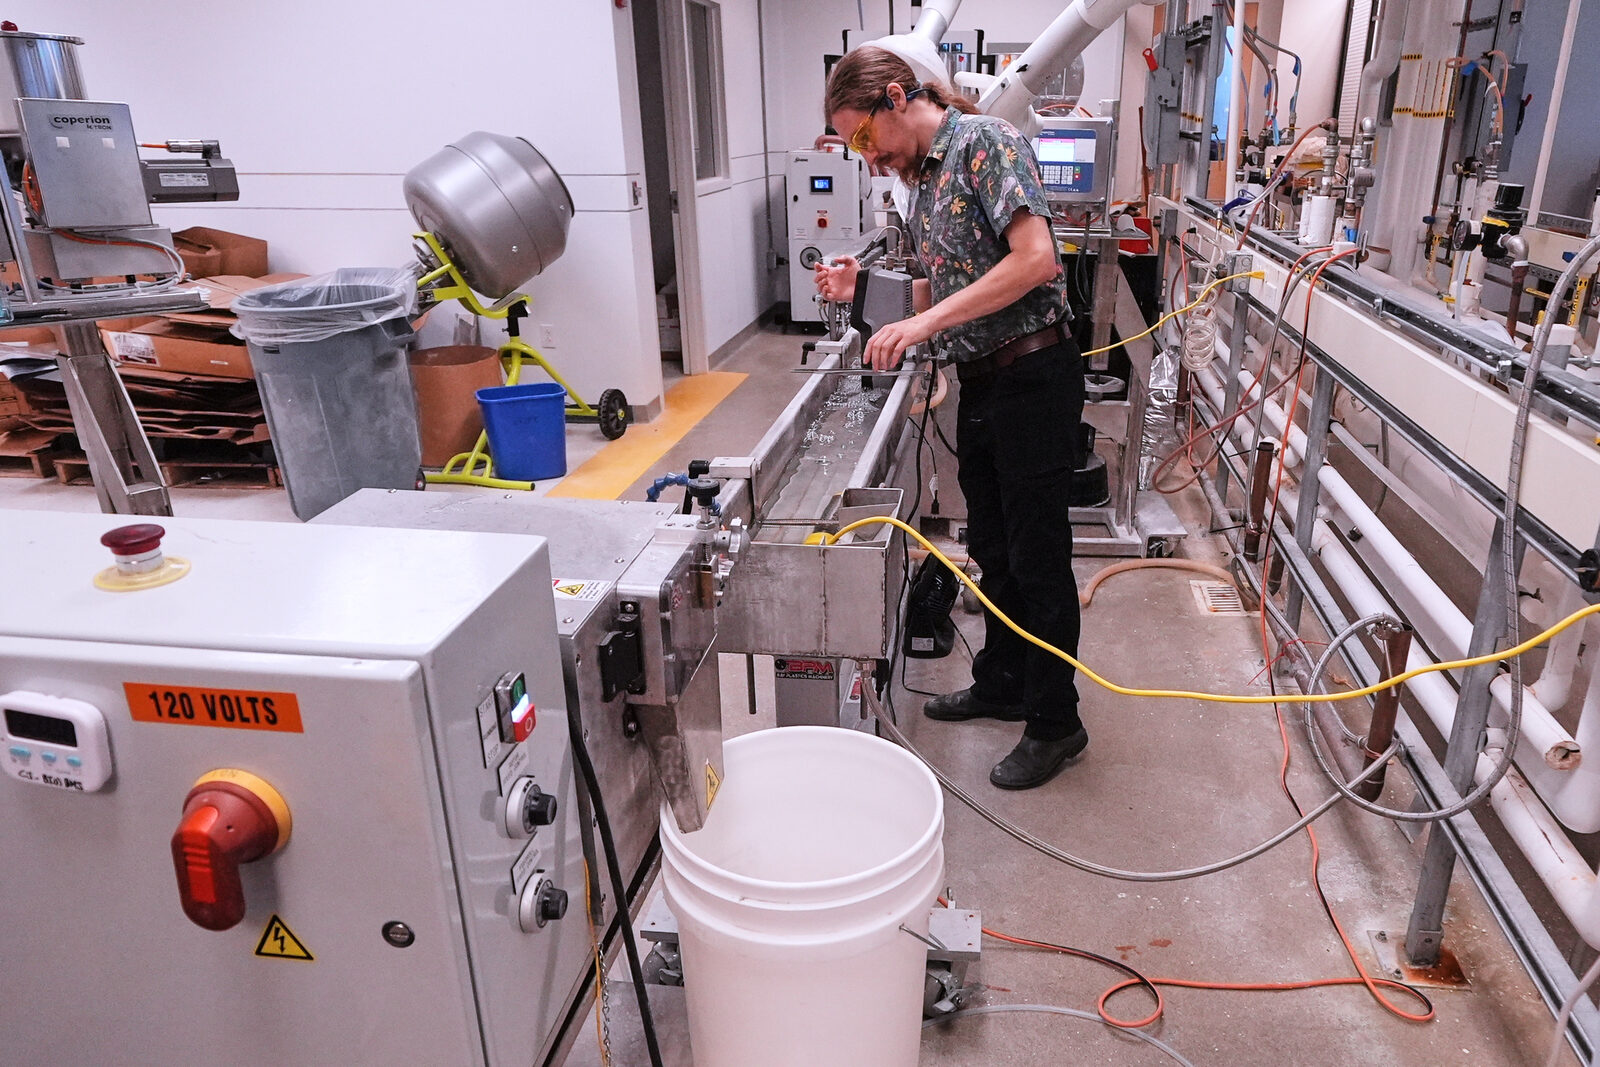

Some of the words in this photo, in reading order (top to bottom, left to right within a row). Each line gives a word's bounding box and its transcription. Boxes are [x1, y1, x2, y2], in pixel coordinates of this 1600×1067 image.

[53, 115, 110, 125] coperion
[787, 660, 833, 673] BPM
[149, 691, 195, 720] 120
[202, 693, 278, 725] VOLTS
